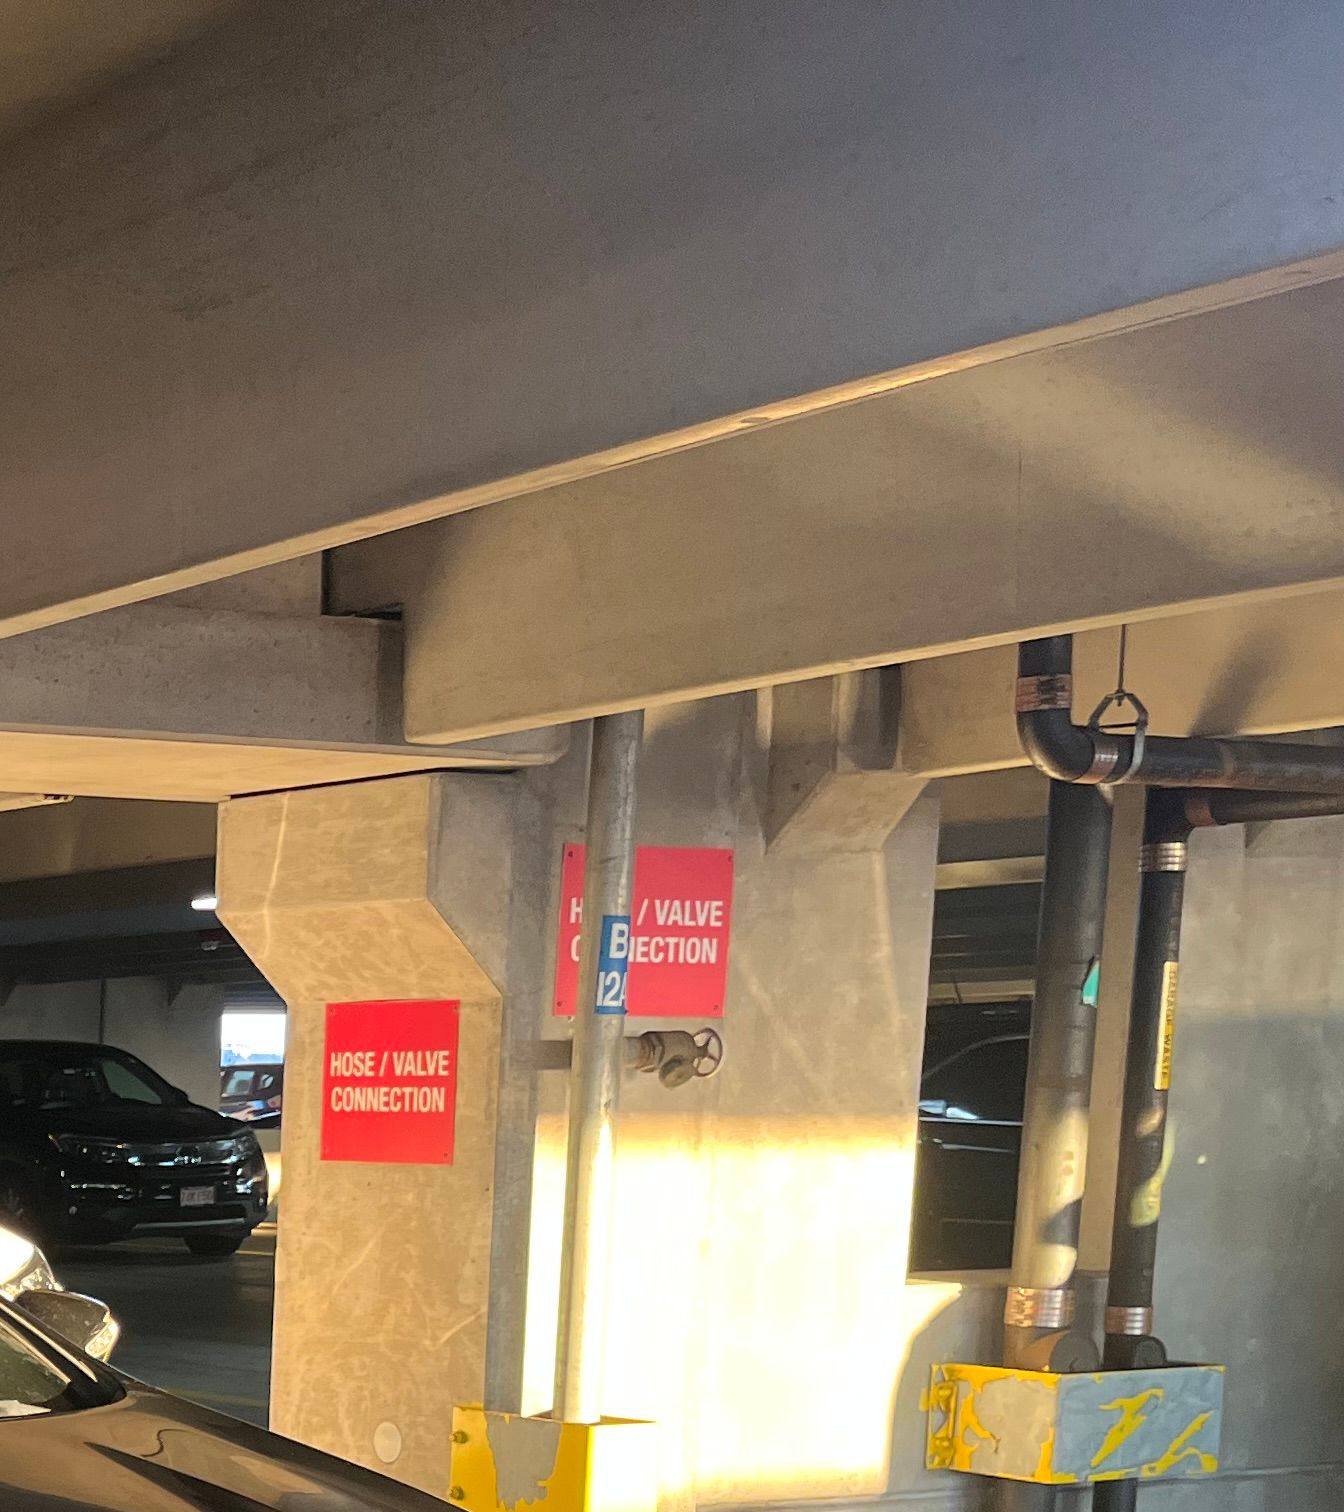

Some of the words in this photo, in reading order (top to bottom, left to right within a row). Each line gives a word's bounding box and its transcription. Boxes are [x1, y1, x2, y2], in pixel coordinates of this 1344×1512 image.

[654, 900, 724, 928] VALVE
[570, 934, 718, 965] CECTION
[609, 922, 629, 959] B
[596, 970, 628, 1007] 12
[330, 1051, 375, 1077] HOSE
[378, 1051, 389, 1077] /
[392, 1050, 450, 1076] VALVE
[331, 1086, 445, 1113] CONNECTION
